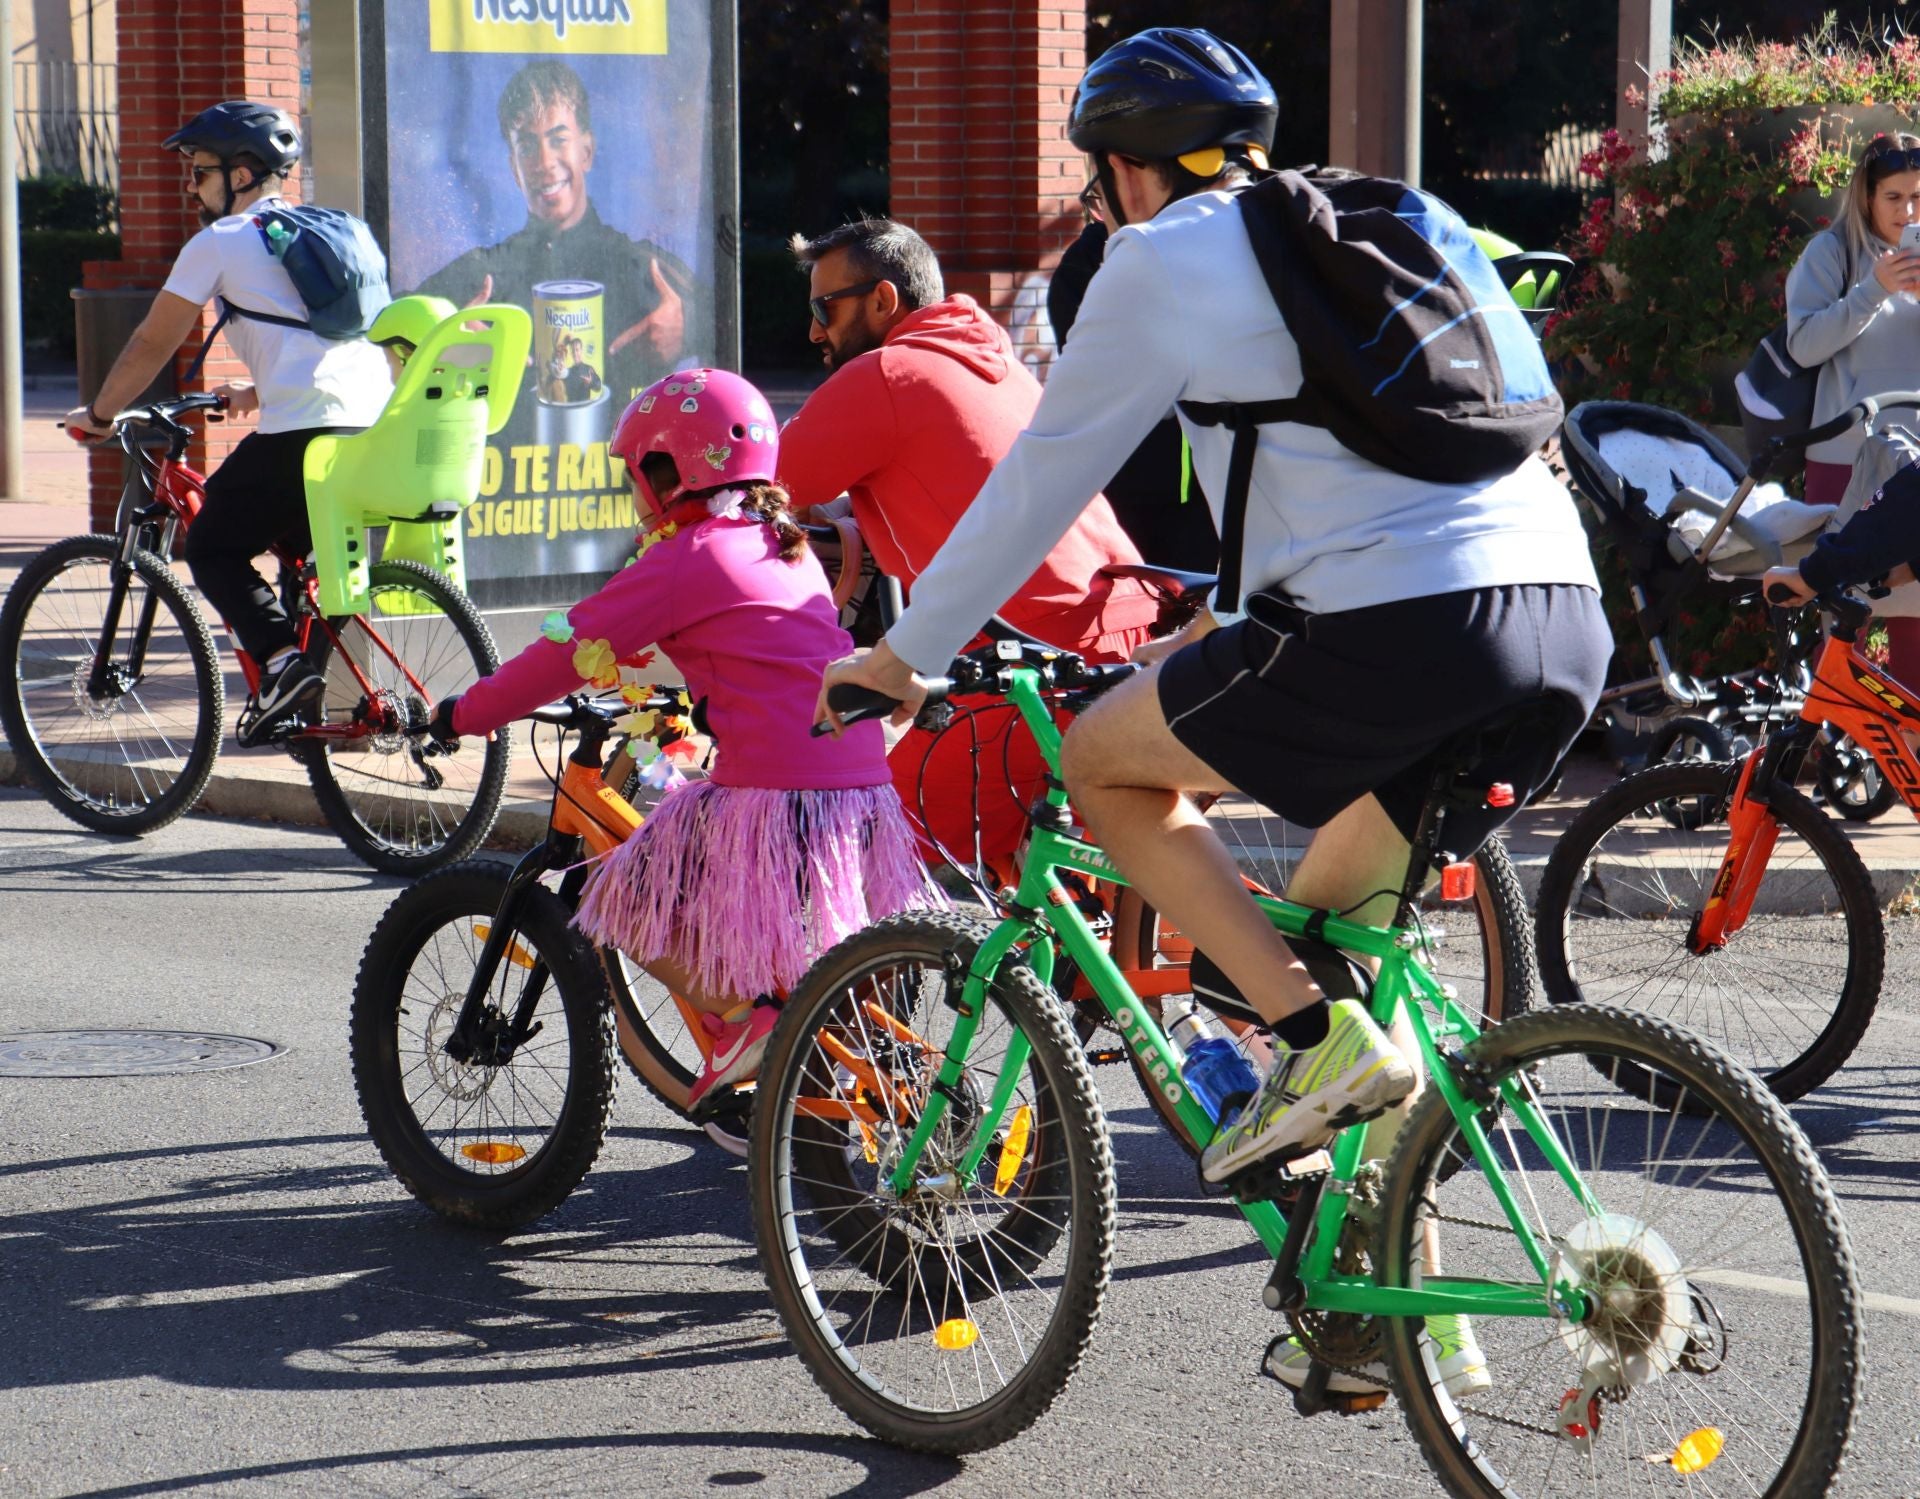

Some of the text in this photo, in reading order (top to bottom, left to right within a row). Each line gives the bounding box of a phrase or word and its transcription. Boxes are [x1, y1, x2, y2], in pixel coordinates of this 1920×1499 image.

[544, 307, 590, 331] Nesquik
[510, 444, 550, 494] TE
[467, 494, 643, 540] SIGUE JUGAN
[1857, 674, 1905, 709] 24
[1116, 1006, 1183, 1104] OTERO
